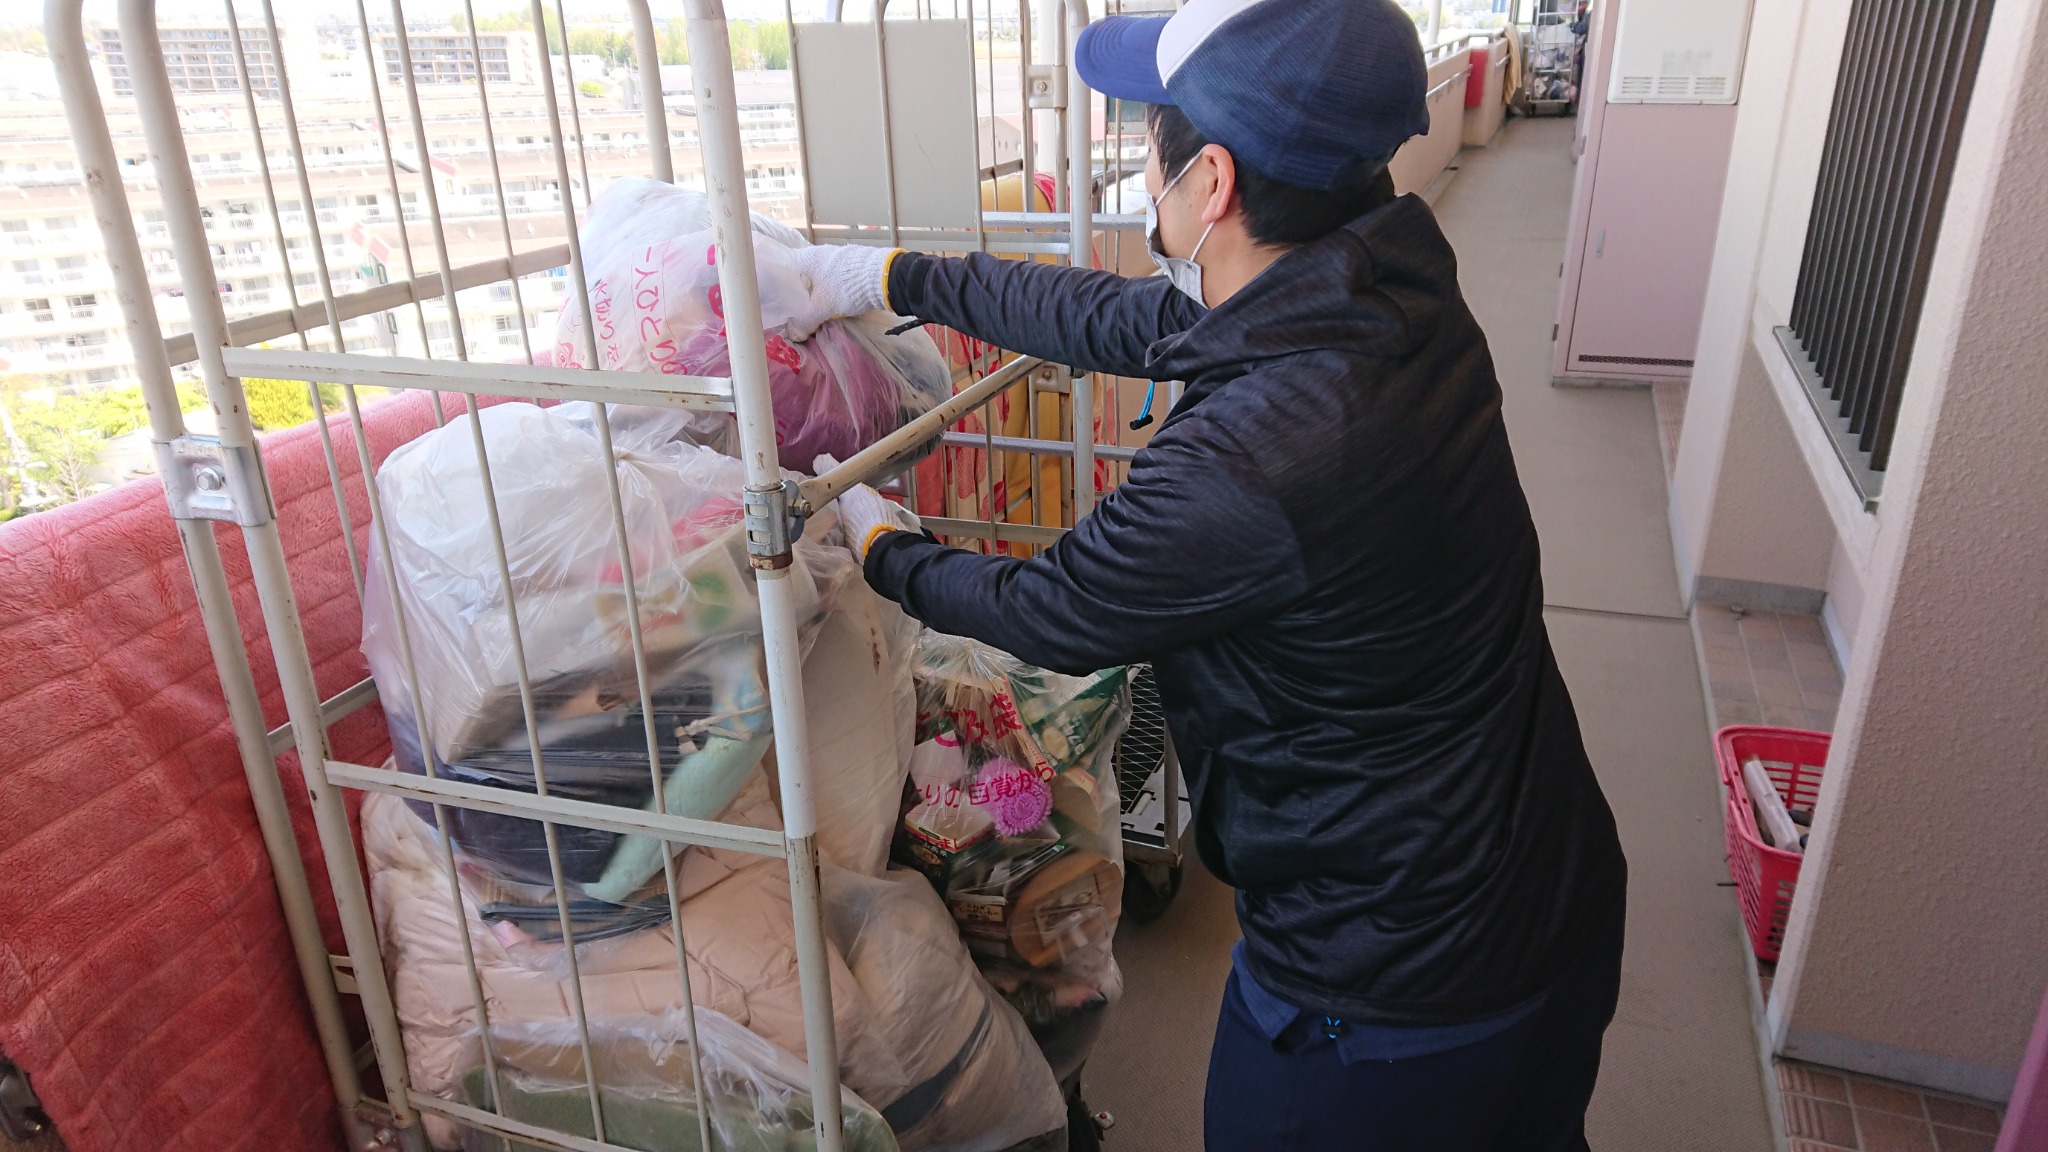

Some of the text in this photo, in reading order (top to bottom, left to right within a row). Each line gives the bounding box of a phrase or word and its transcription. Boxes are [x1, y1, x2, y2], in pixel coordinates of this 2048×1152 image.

[635, 246, 688, 376] 一人ひとりの
